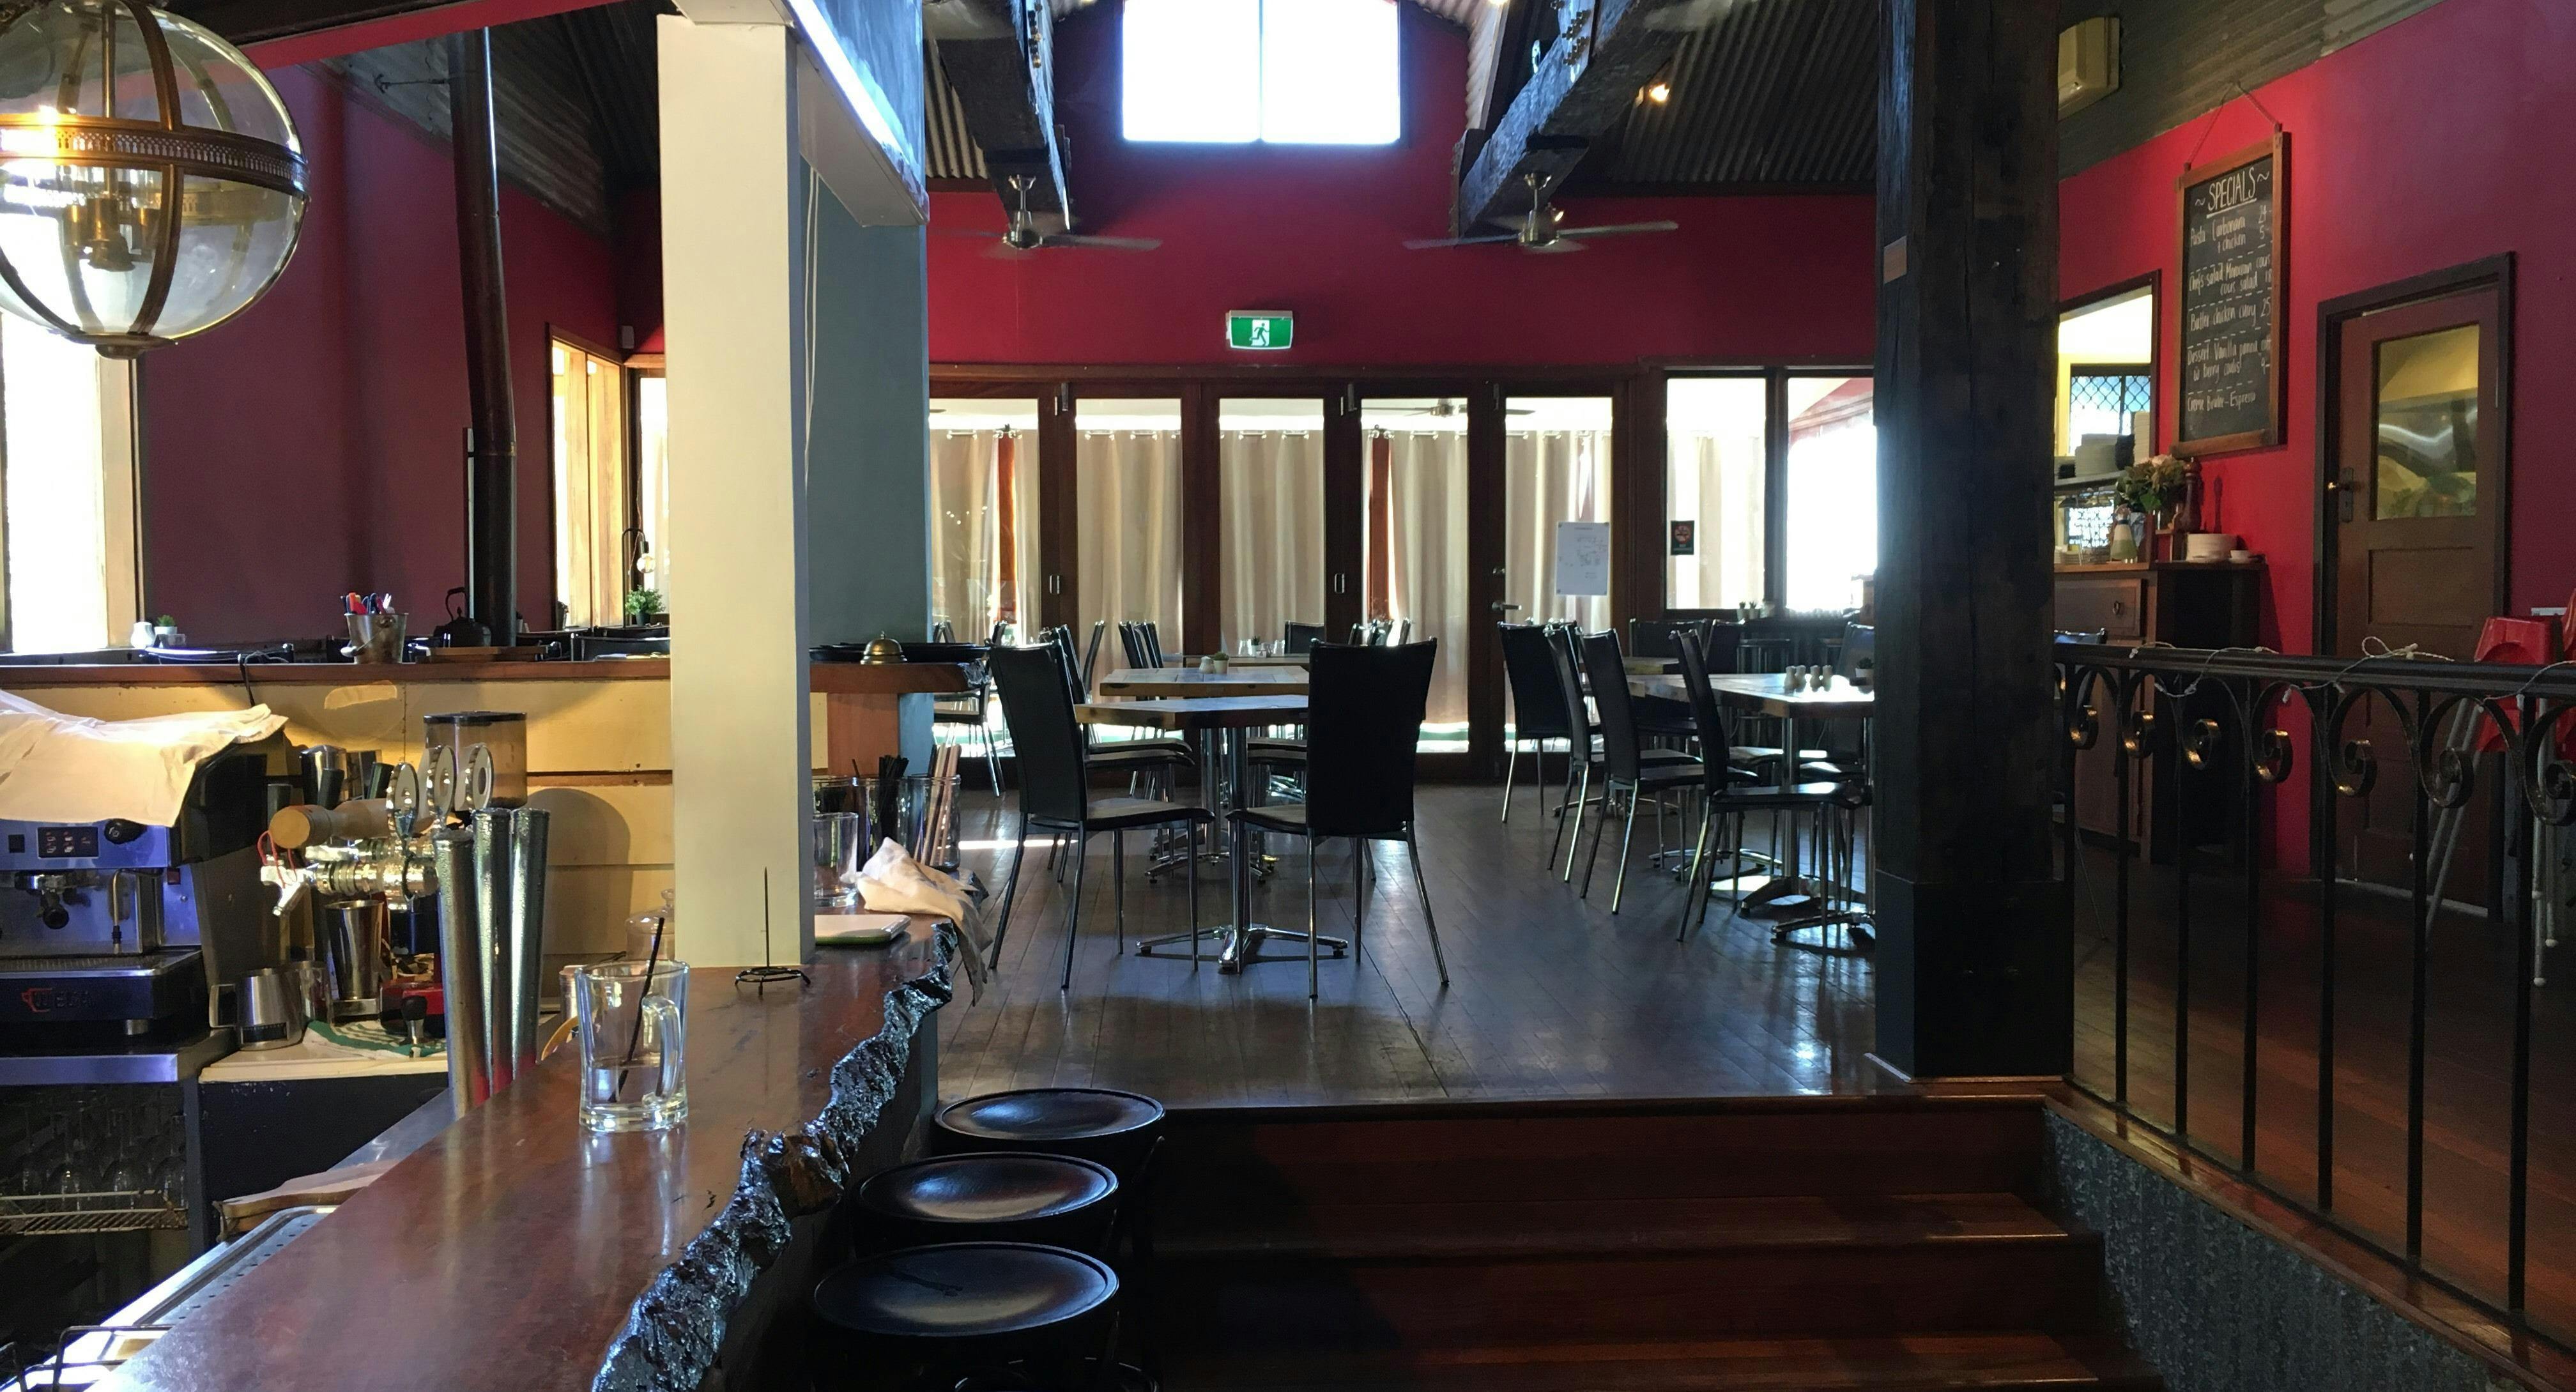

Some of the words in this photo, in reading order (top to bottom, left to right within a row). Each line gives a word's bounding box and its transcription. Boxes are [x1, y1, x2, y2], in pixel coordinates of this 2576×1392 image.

[2207, 167, 2256, 211] SPECIALS
[2190, 226, 2205, 247] Pasta
[2212, 216, 2245, 241] Carbonara
[2222, 233, 2246, 252] chicken
[2206, 263, 2223, 286] salad
[2256, 254, 2270, 268] cous
[2220, 281, 2235, 296] cous
[2240, 270, 2258, 291] salad
[2190, 312, 2209, 331] Butter
[2213, 305, 2235, 325] chicken
[2239, 304, 2256, 327] curry
[2188, 343, 2209, 365] Dessert
[2214, 339, 2237, 360] Vanilla
[2204, 363, 2220, 384] berry
